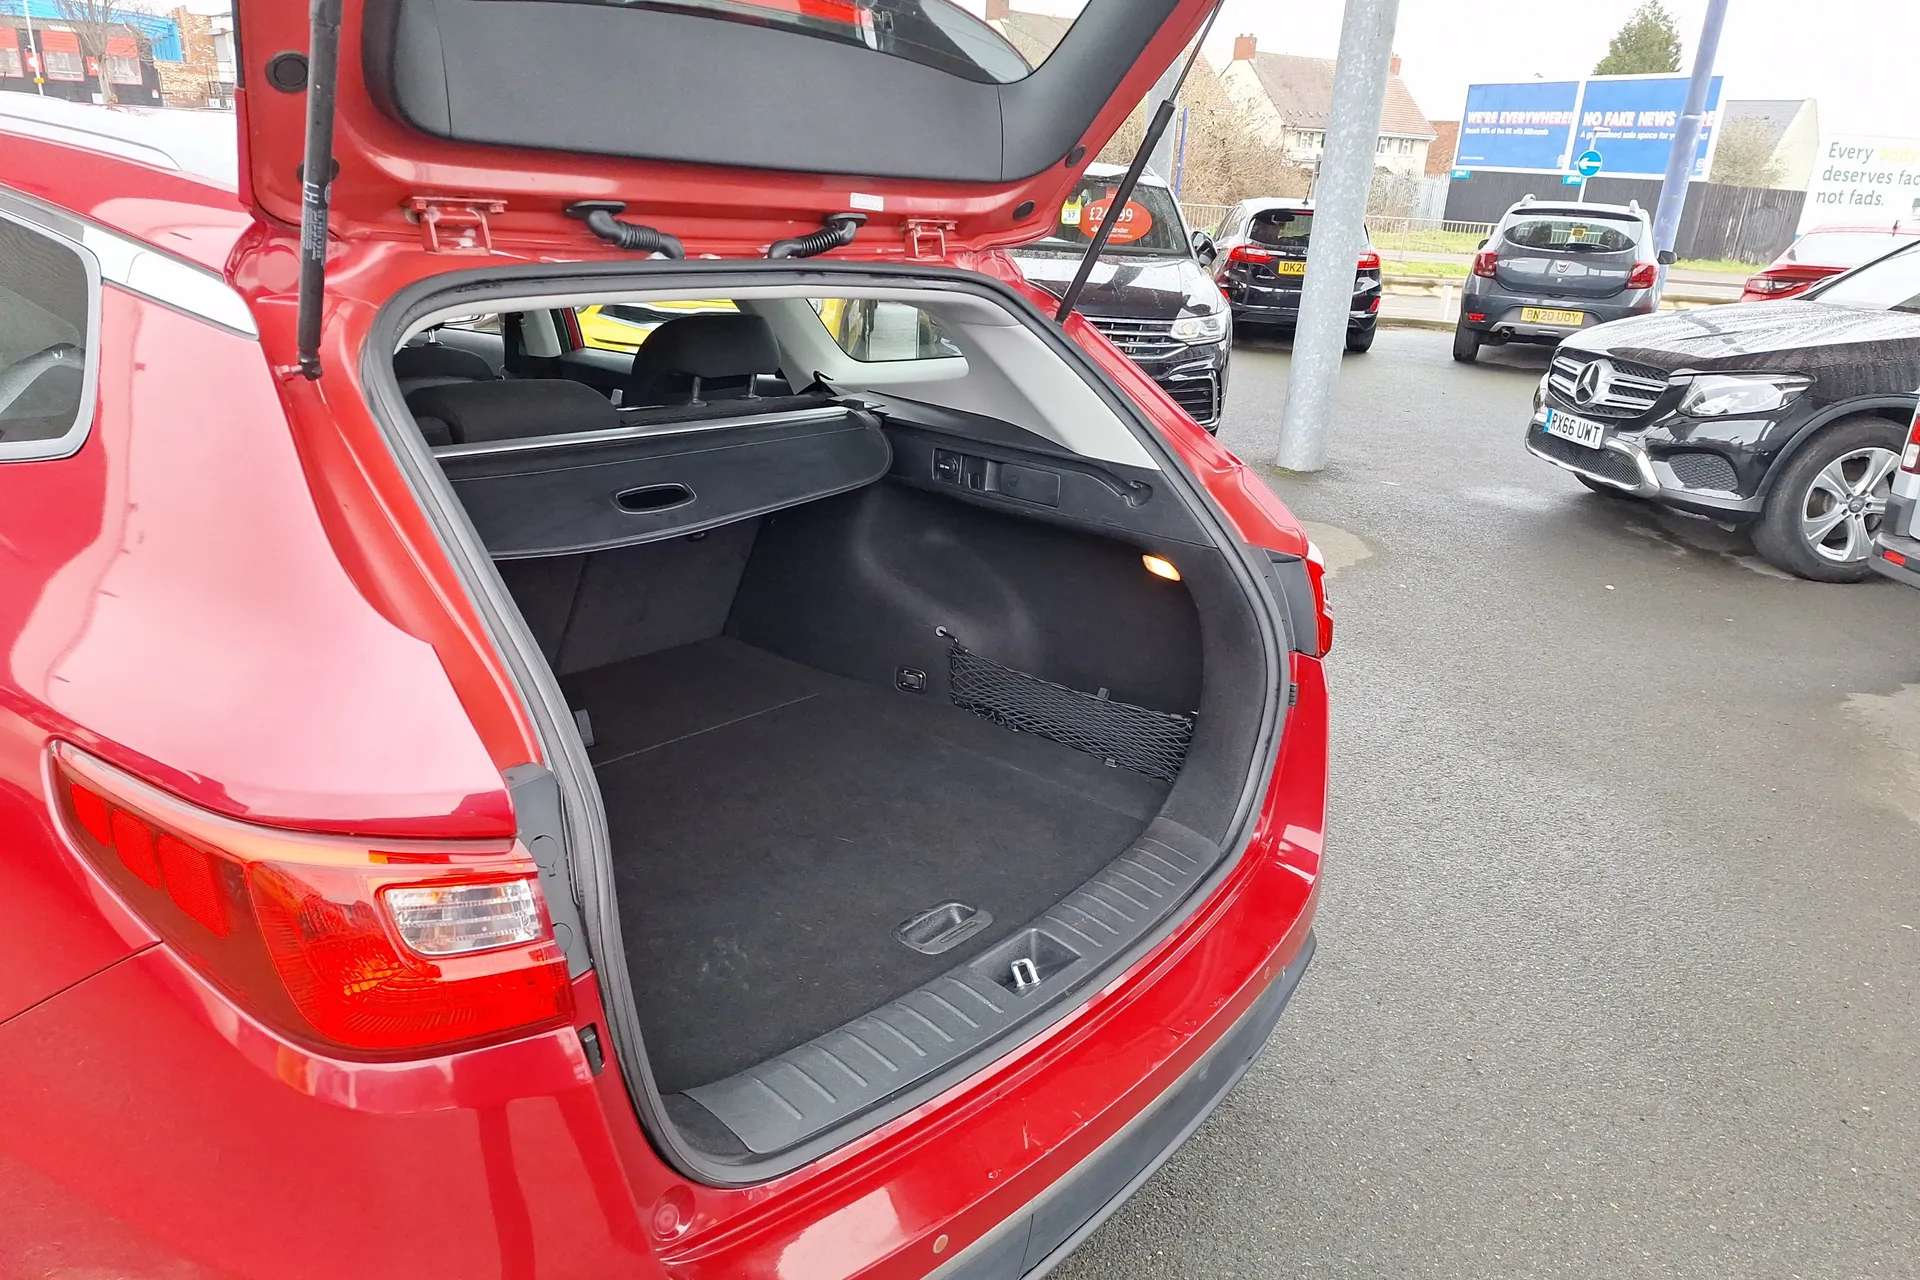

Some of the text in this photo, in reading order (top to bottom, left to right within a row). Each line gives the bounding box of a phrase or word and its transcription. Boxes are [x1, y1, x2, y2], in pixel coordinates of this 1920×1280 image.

[1582, 112, 1602, 126] NO
[1603, 111, 1636, 127] FAKE
[1638, 111, 1677, 127] NEWS
[1828, 142, 1874, 164] Every
[1822, 165, 1893, 184] deserves
[304, 181, 320, 204] LH
[1816, 188, 1884, 207] not fads.
[1550, 413, 1600, 443] RX66 UWT
